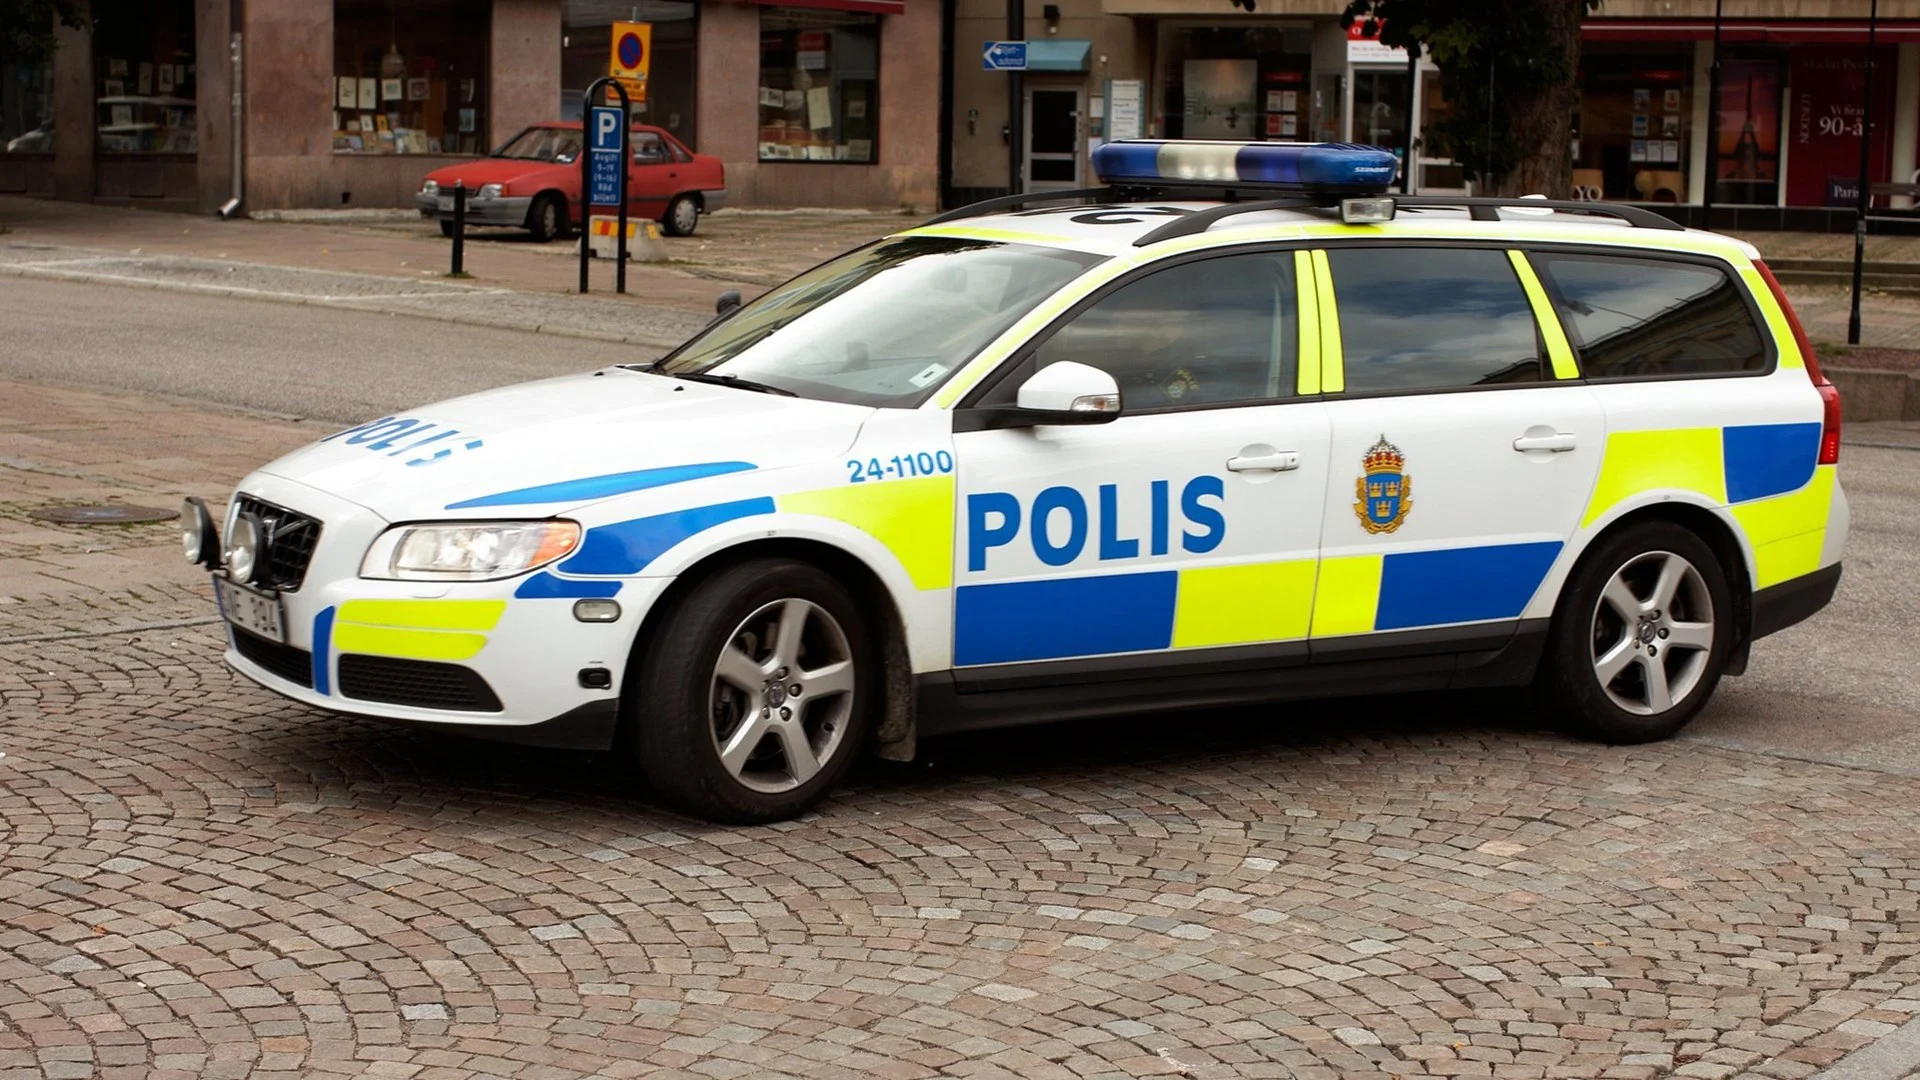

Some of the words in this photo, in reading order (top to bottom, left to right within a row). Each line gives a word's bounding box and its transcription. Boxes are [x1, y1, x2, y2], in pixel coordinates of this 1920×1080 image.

[598, 112, 616, 146] P
[594, 153, 618, 163] Avgift
[593, 173, 617, 182] (9-16)
[593, 193, 617, 203] biljett
[846, 449, 953, 484] 24-1100
[967, 475, 1227, 572] POLIS
